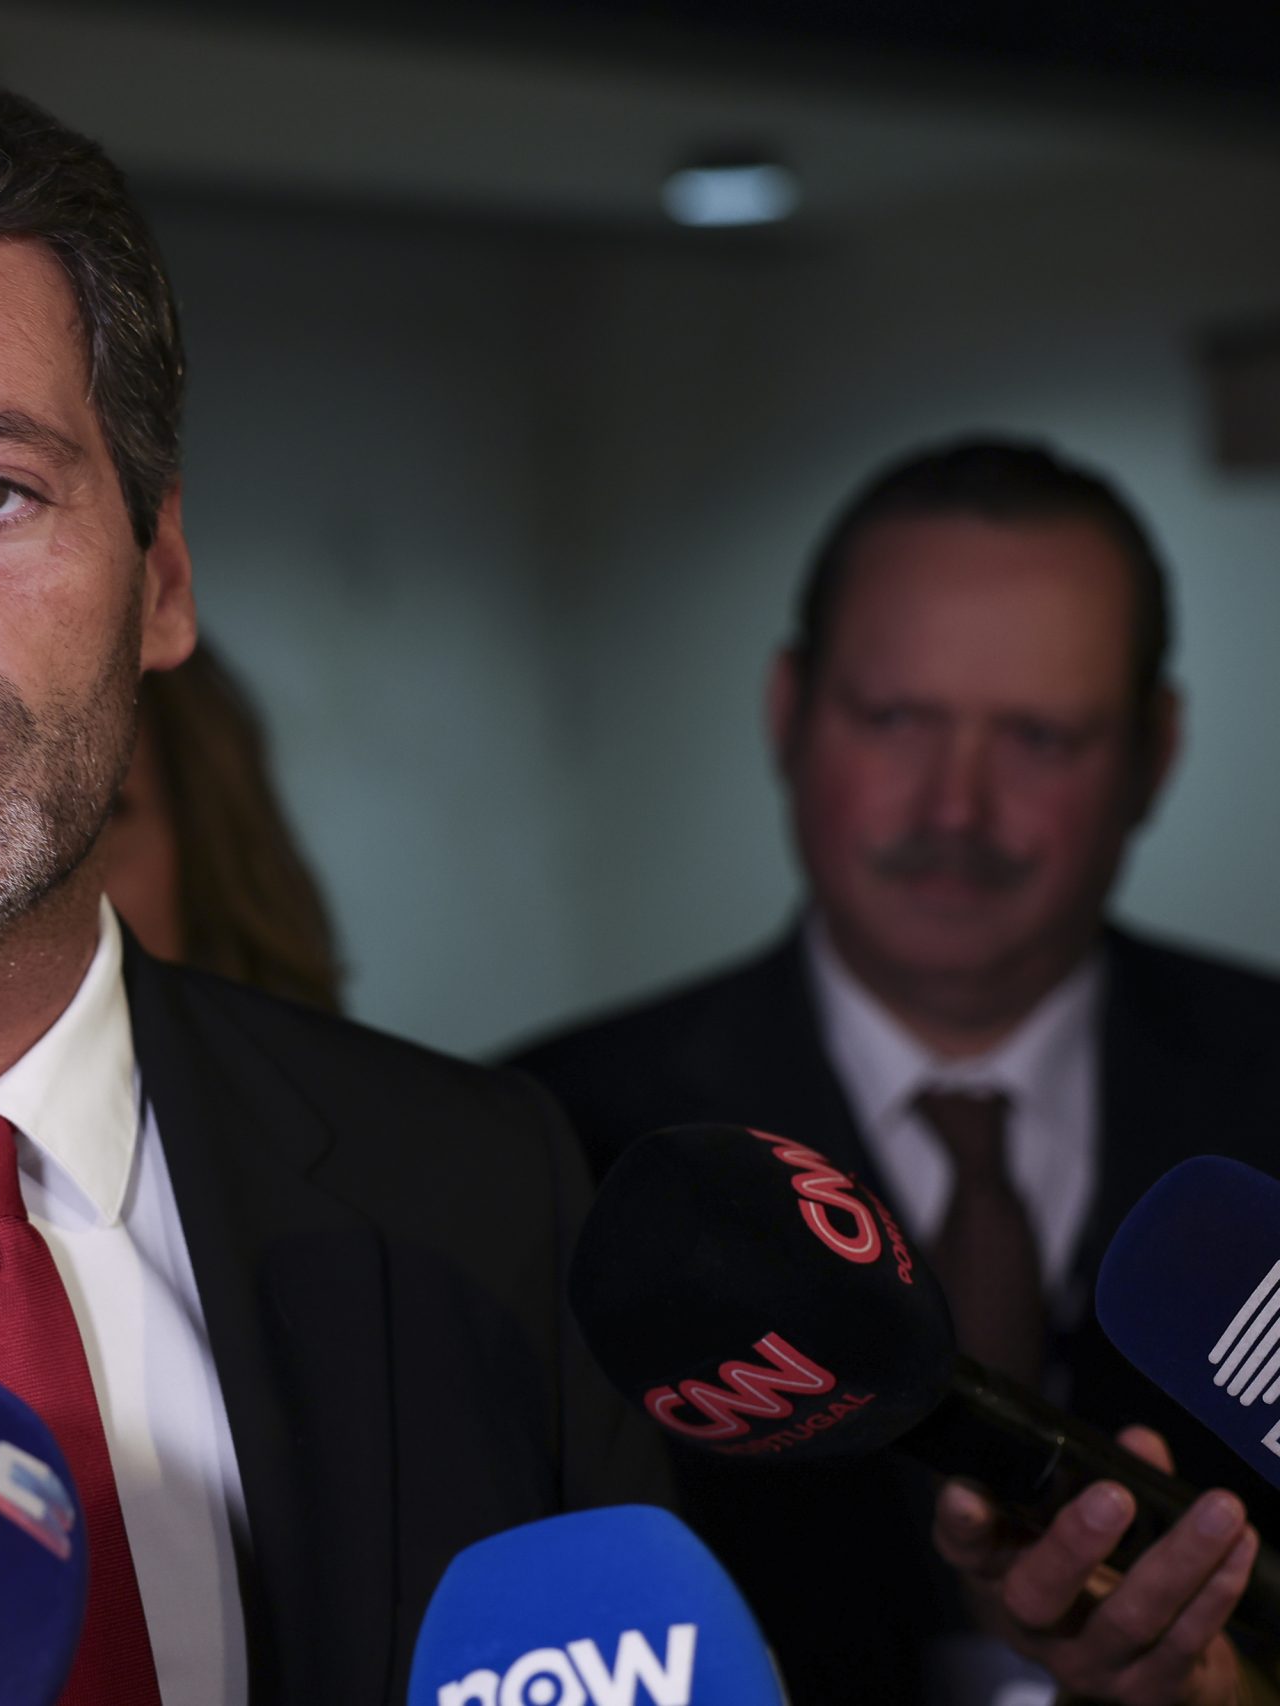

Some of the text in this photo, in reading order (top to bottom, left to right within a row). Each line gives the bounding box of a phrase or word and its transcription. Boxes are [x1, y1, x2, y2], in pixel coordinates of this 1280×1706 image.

[744, 1126, 883, 1265] CNN
[643, 1330, 838, 1440] CNN
[710, 1392, 878, 1454] TUGAL
